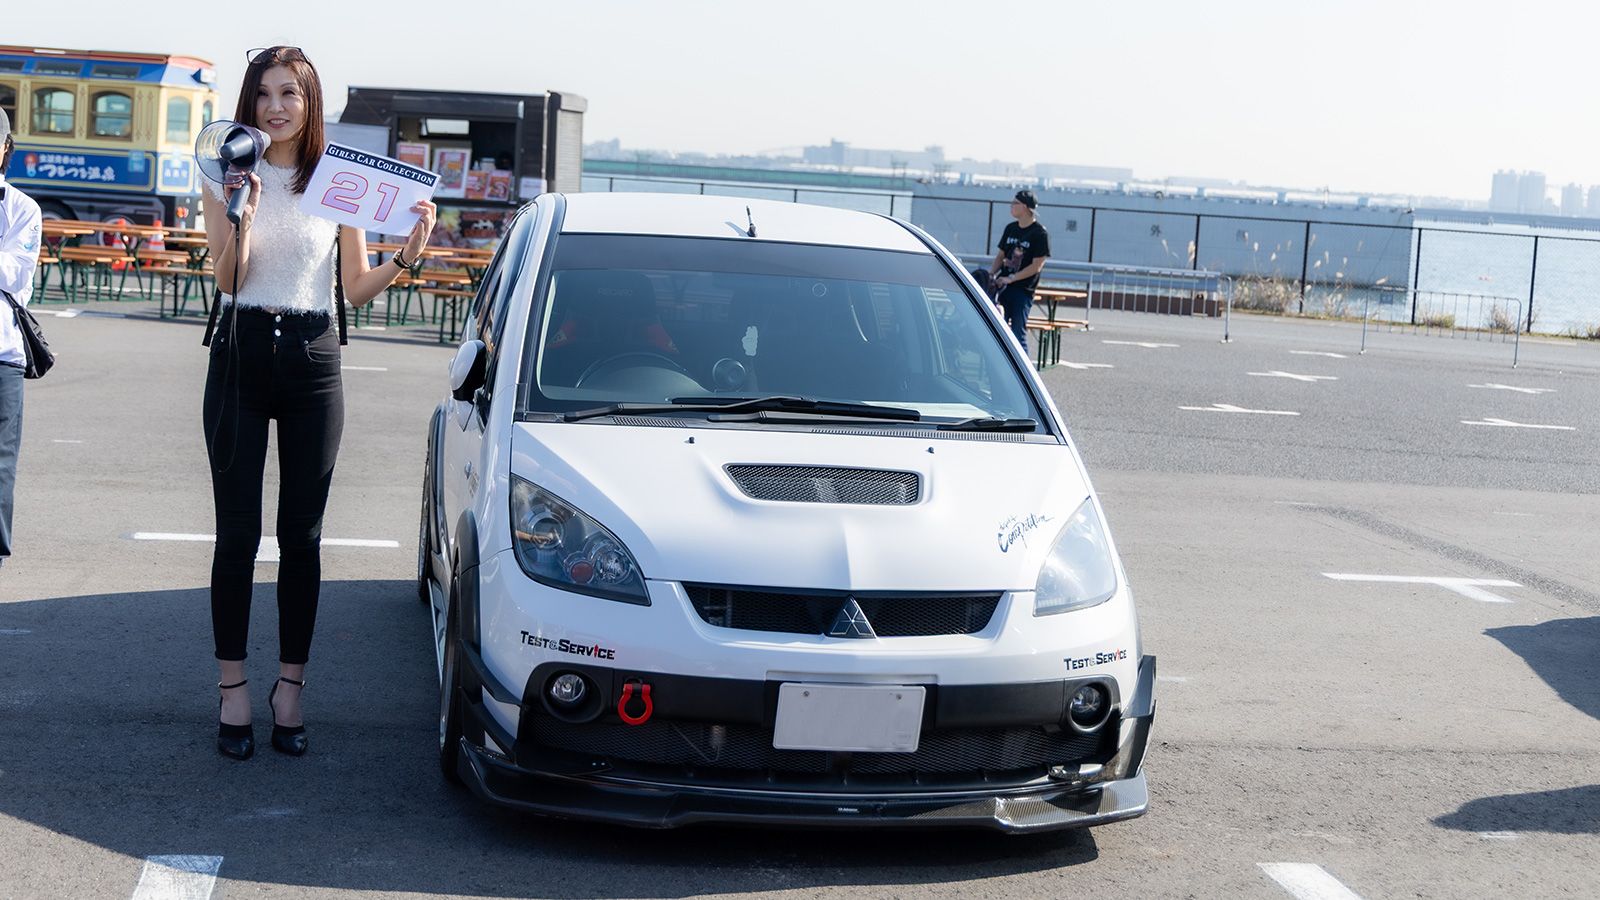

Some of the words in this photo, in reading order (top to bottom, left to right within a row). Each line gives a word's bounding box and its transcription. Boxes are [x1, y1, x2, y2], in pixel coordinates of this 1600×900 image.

[328, 146, 356, 160] GIRLS
[357, 154, 375, 167] CAR
[377, 160, 434, 185] COLLECTION
[321, 171, 400, 222] 21
